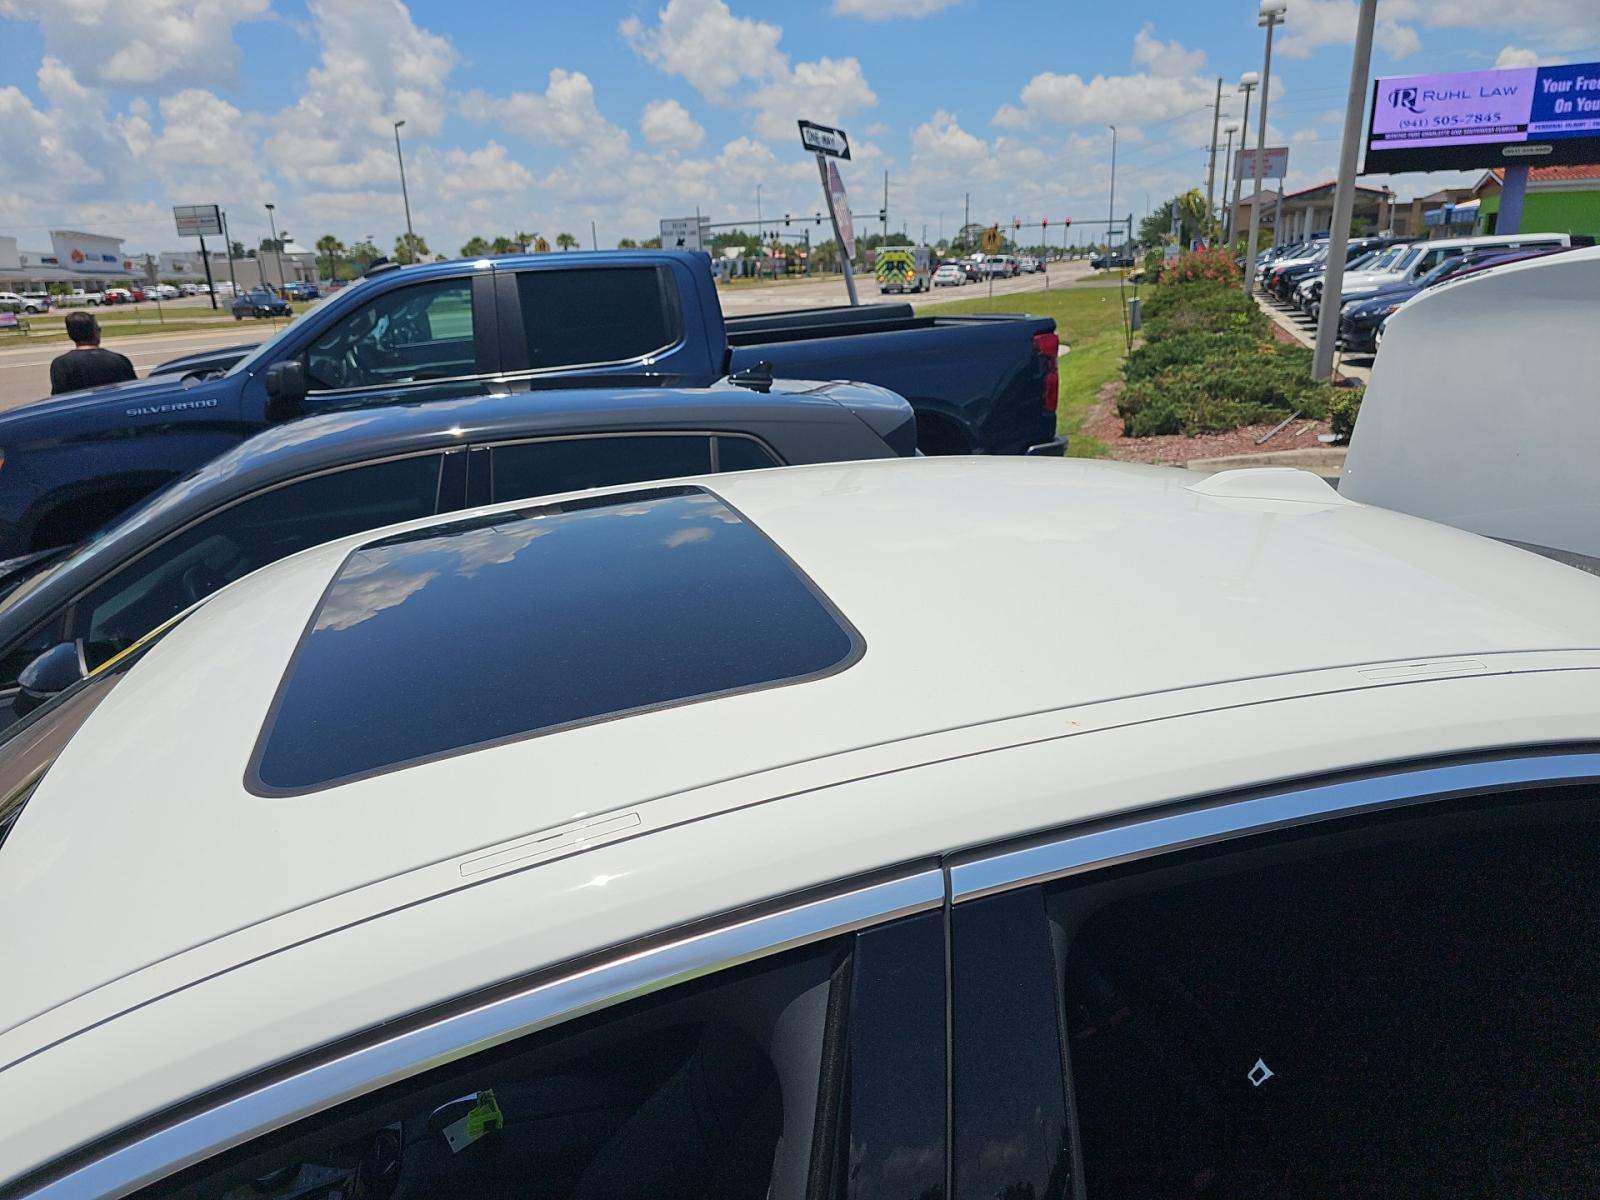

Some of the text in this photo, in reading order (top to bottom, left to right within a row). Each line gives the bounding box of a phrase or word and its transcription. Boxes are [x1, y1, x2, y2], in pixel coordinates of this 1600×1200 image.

[1543, 78, 1573, 93] Your
[1422, 90, 1471, 101] RUHL
[1554, 98, 1573, 113] On
[1399, 112, 1501, 130] (941) 505-7845
[126, 399, 218, 417] SILVERADO
